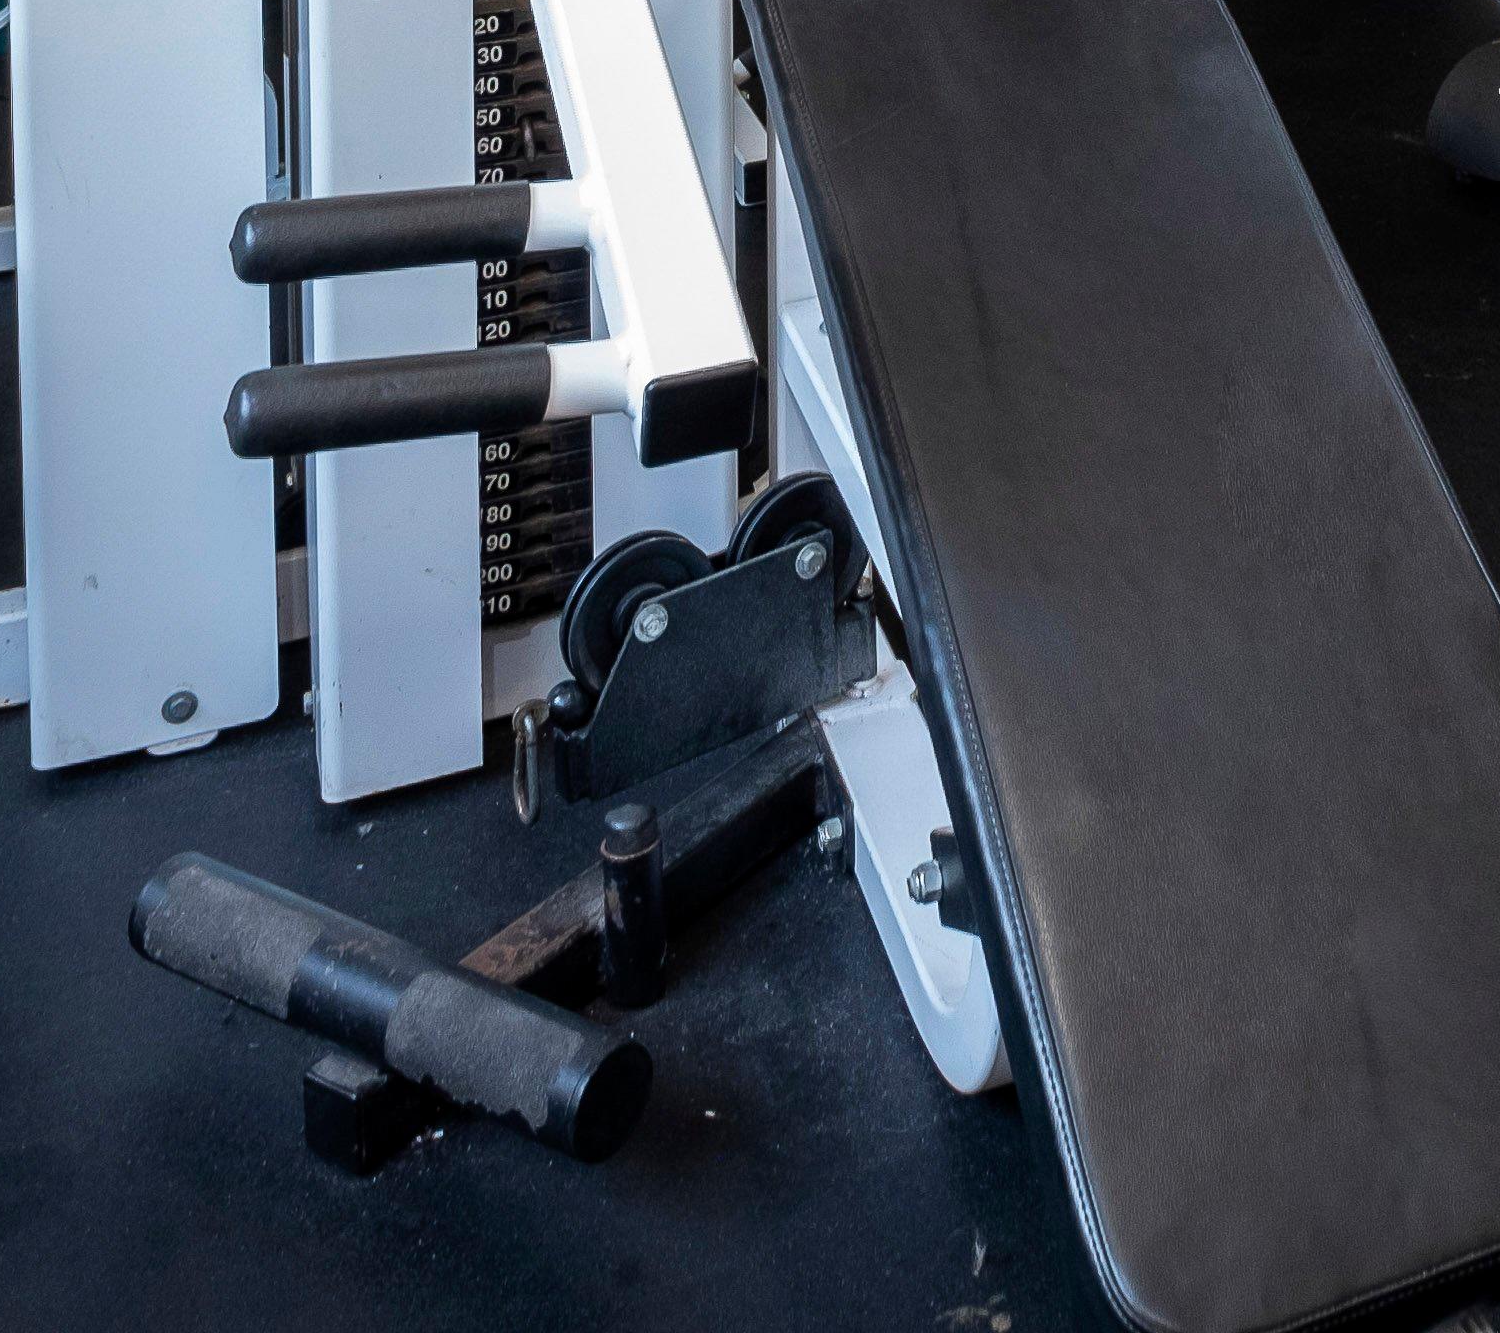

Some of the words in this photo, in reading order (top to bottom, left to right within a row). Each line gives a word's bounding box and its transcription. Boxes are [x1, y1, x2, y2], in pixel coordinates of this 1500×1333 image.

[474, 16, 499, 35] 20
[477, 46, 502, 64] 30
[474, 77, 499, 95] 40
[476, 108, 501, 126] 50
[477, 137, 502, 154] 60
[479, 168, 504, 184] 70
[482, 260, 508, 279] 00
[480, 442, 510, 461] 60
[480, 473, 510, 492] 70
[482, 594, 511, 614] 10
